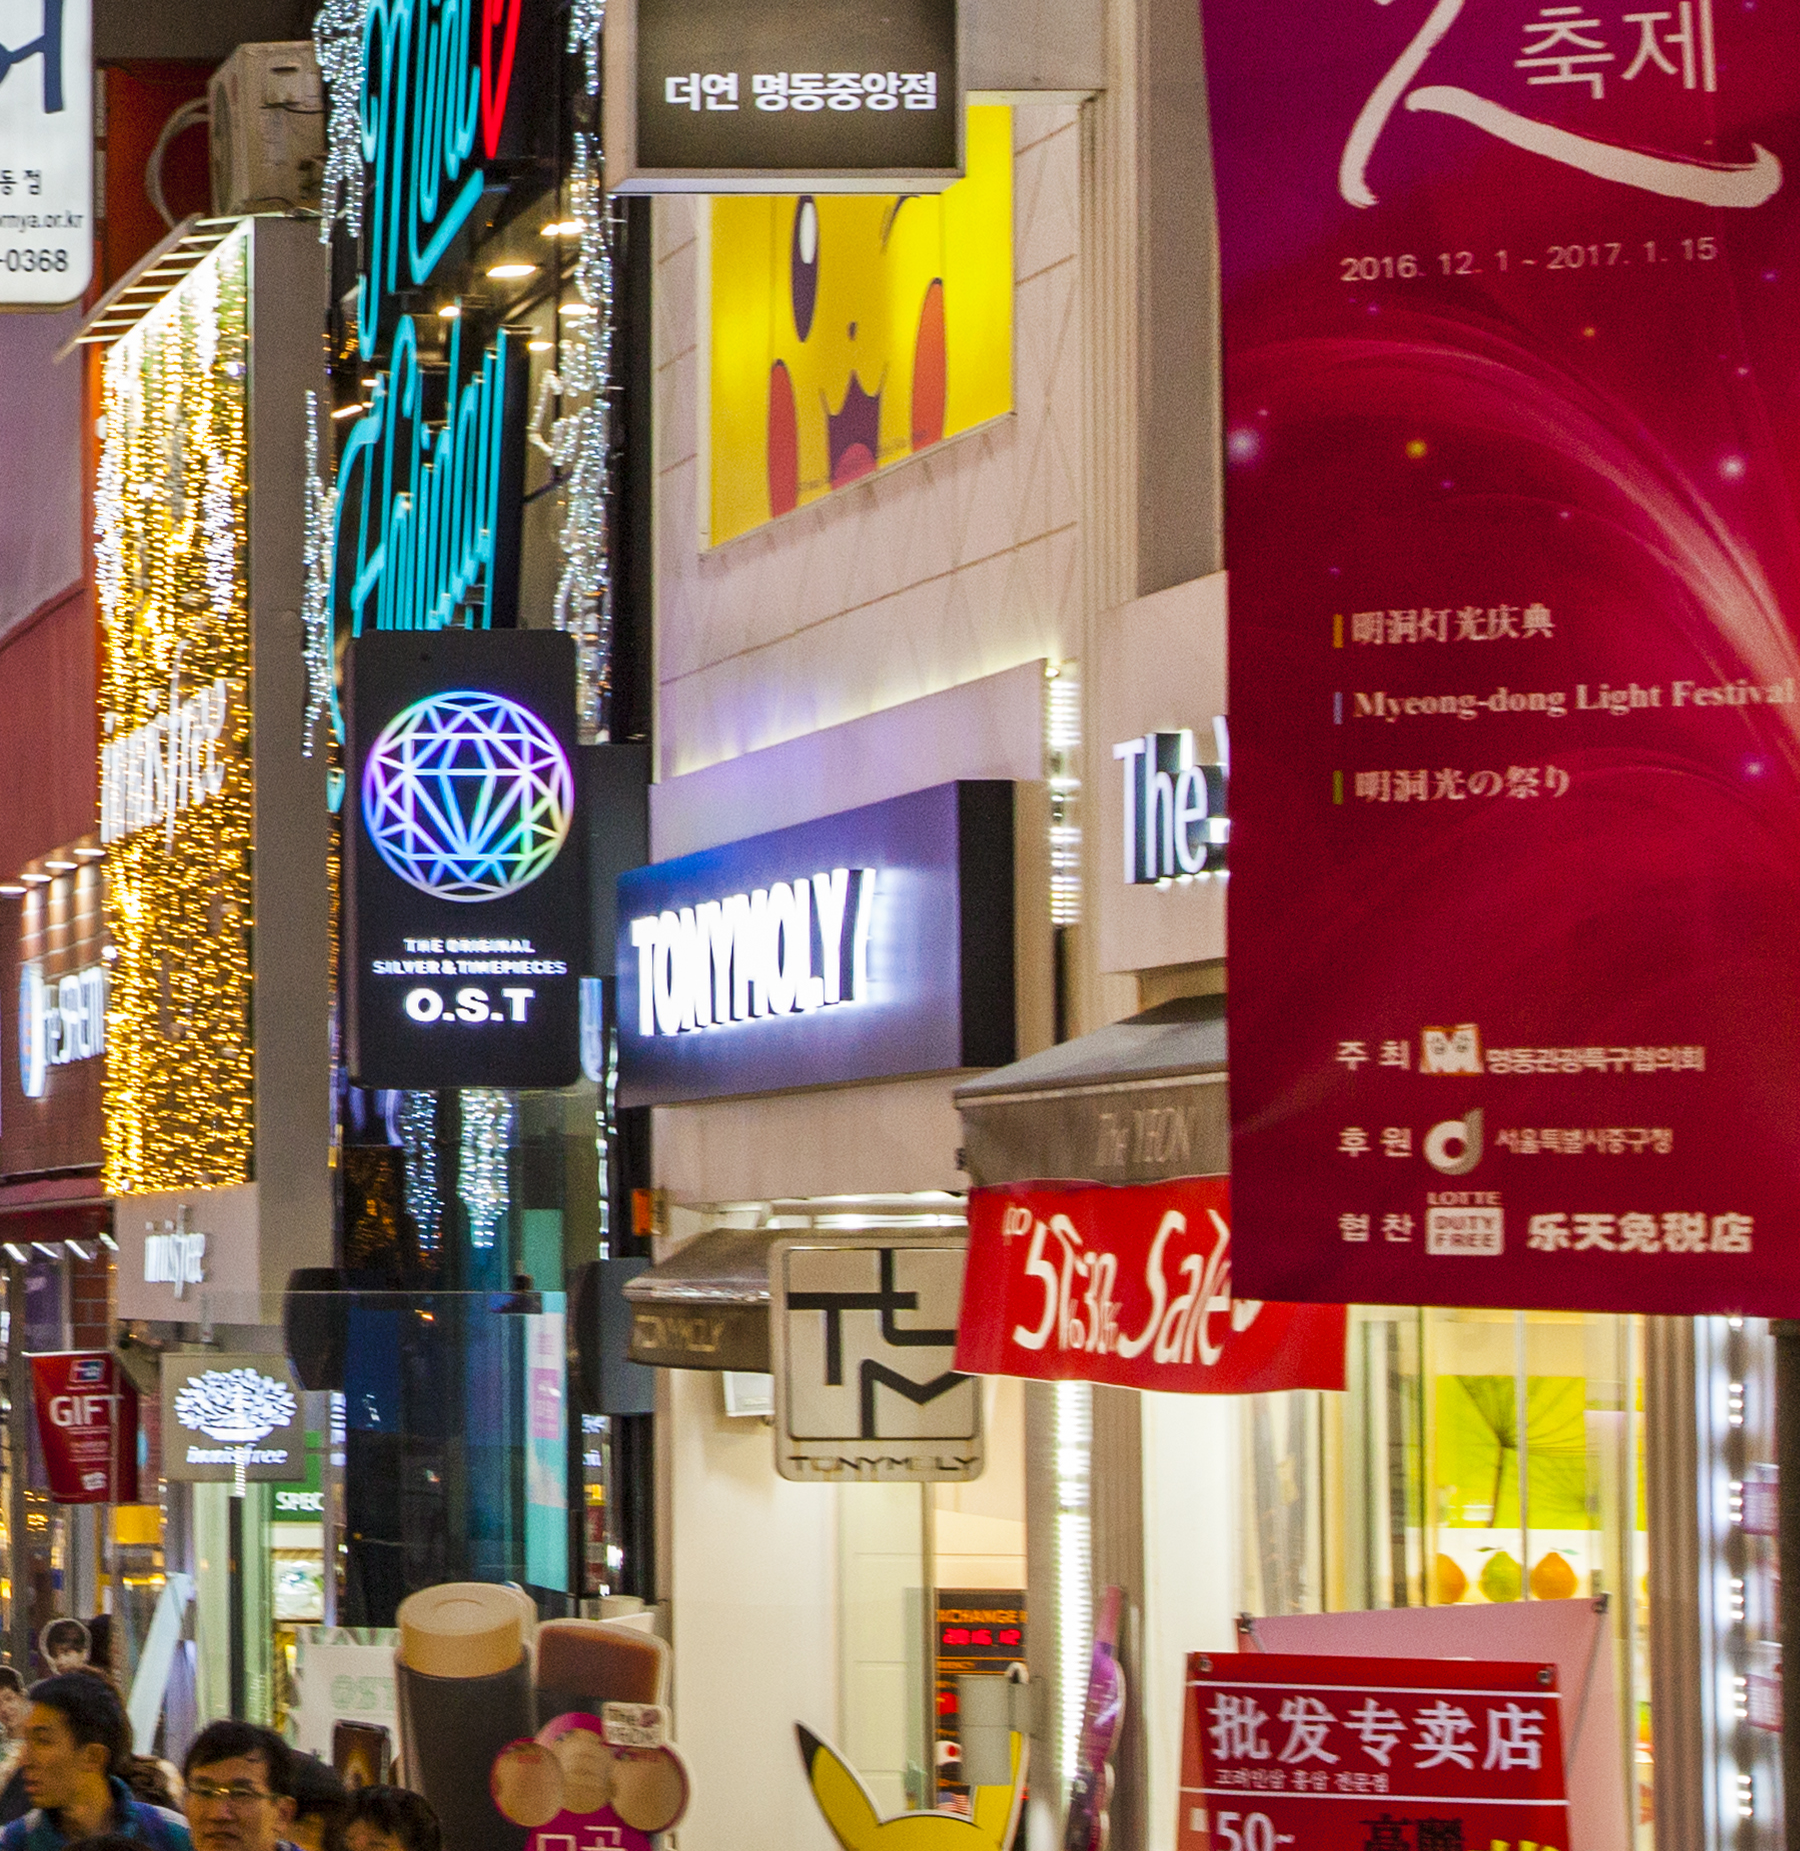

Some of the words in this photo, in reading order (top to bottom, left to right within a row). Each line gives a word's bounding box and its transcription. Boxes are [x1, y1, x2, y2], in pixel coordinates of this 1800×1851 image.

[664, 71, 741, 113] 더연
[751, 70, 938, 113] 명동중앙점
[1679, 235, 1719, 263] 15
[1352, 686, 1568, 724] Myeong-dong
[1574, 682, 1664, 717] Light
[1670, 676, 1797, 710] Festival
[1353, 764, 1572, 805] 明洞光の祭り
[1113, 729, 1208, 886] The
[631, 867, 877, 1037] TONYMOLY
[404, 986, 536, 1024] O.S.T
[1527, 1211, 1755, 1253] 乐天免税店
[50, 1393, 124, 1427] GIFT
[1205, 1692, 1547, 1771] 批发专卖店
